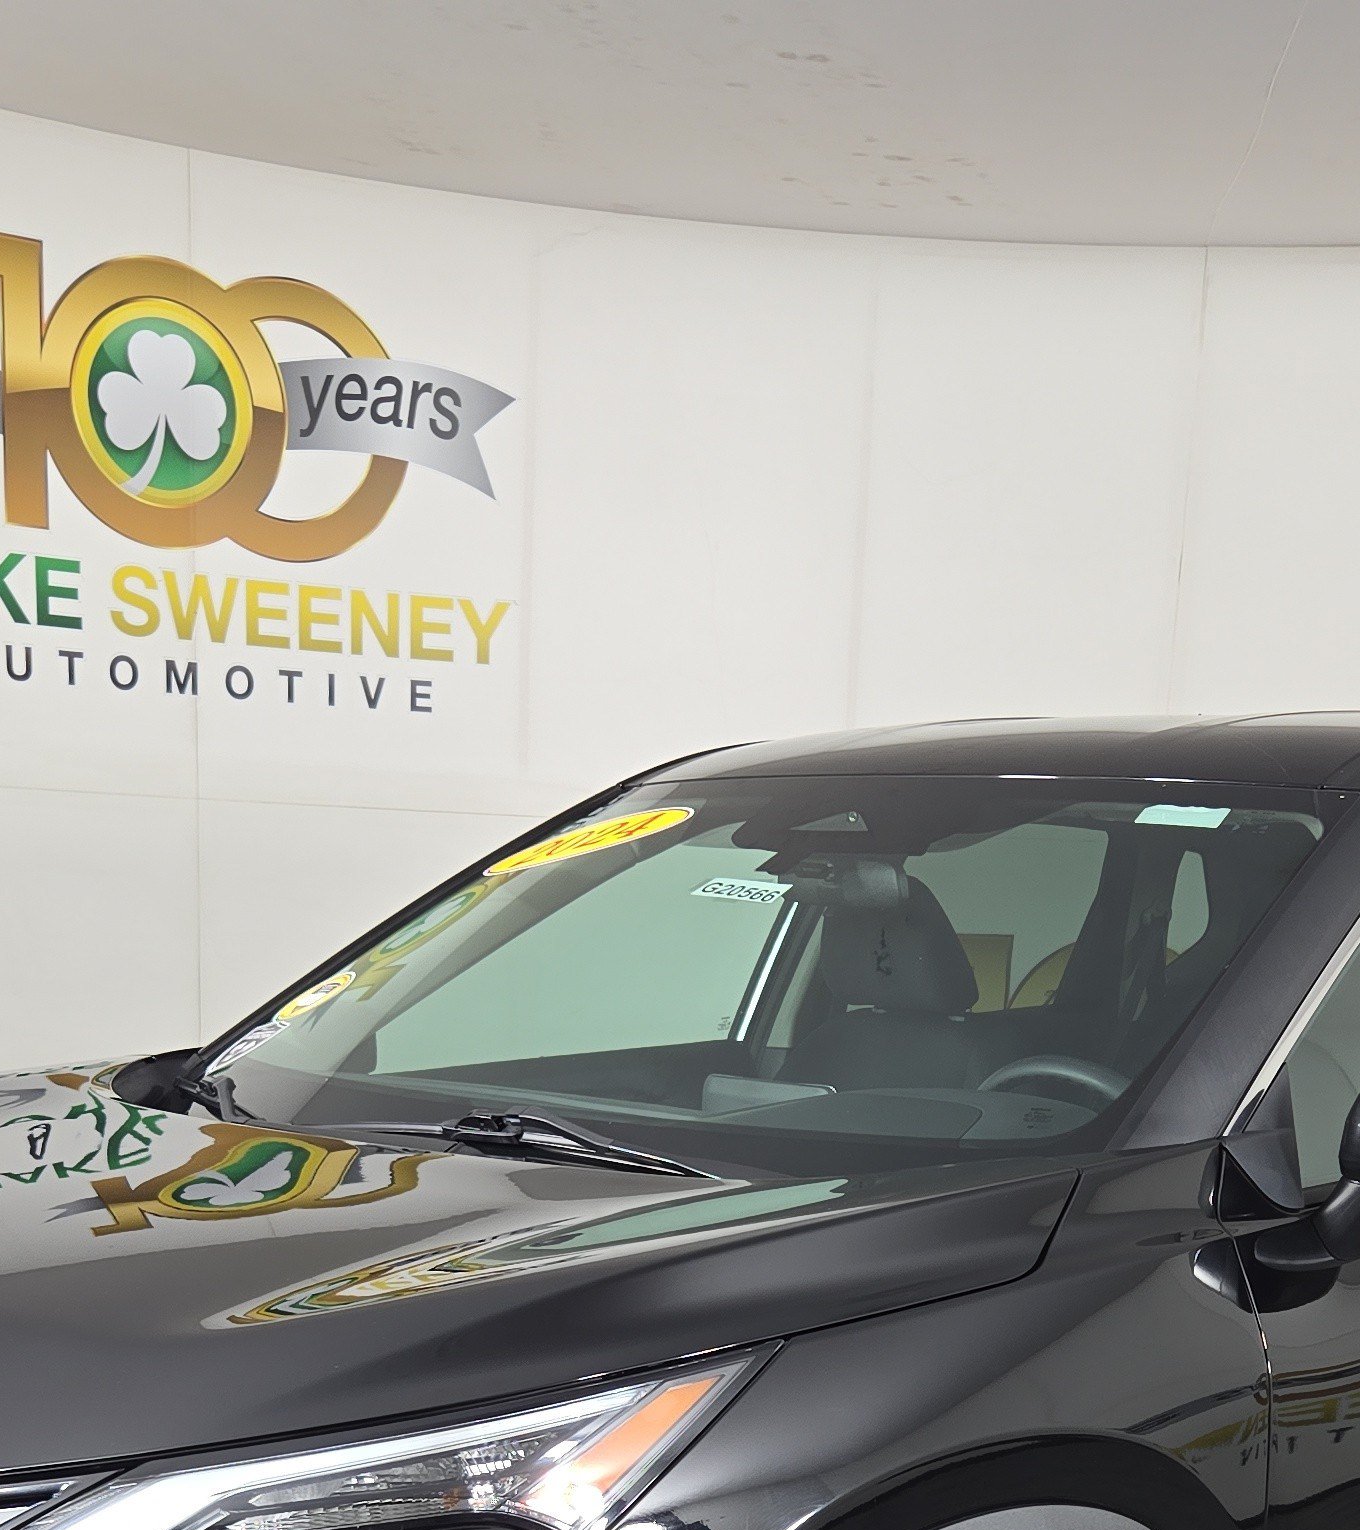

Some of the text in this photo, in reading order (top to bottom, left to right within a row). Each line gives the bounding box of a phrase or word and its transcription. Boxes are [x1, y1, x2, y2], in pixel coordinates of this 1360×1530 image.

[299, 369, 462, 440] years
[109, 566, 510, 665] SWEENEY
[510, 813, 665, 867] 2024
[702, 882, 780, 902] G20566
